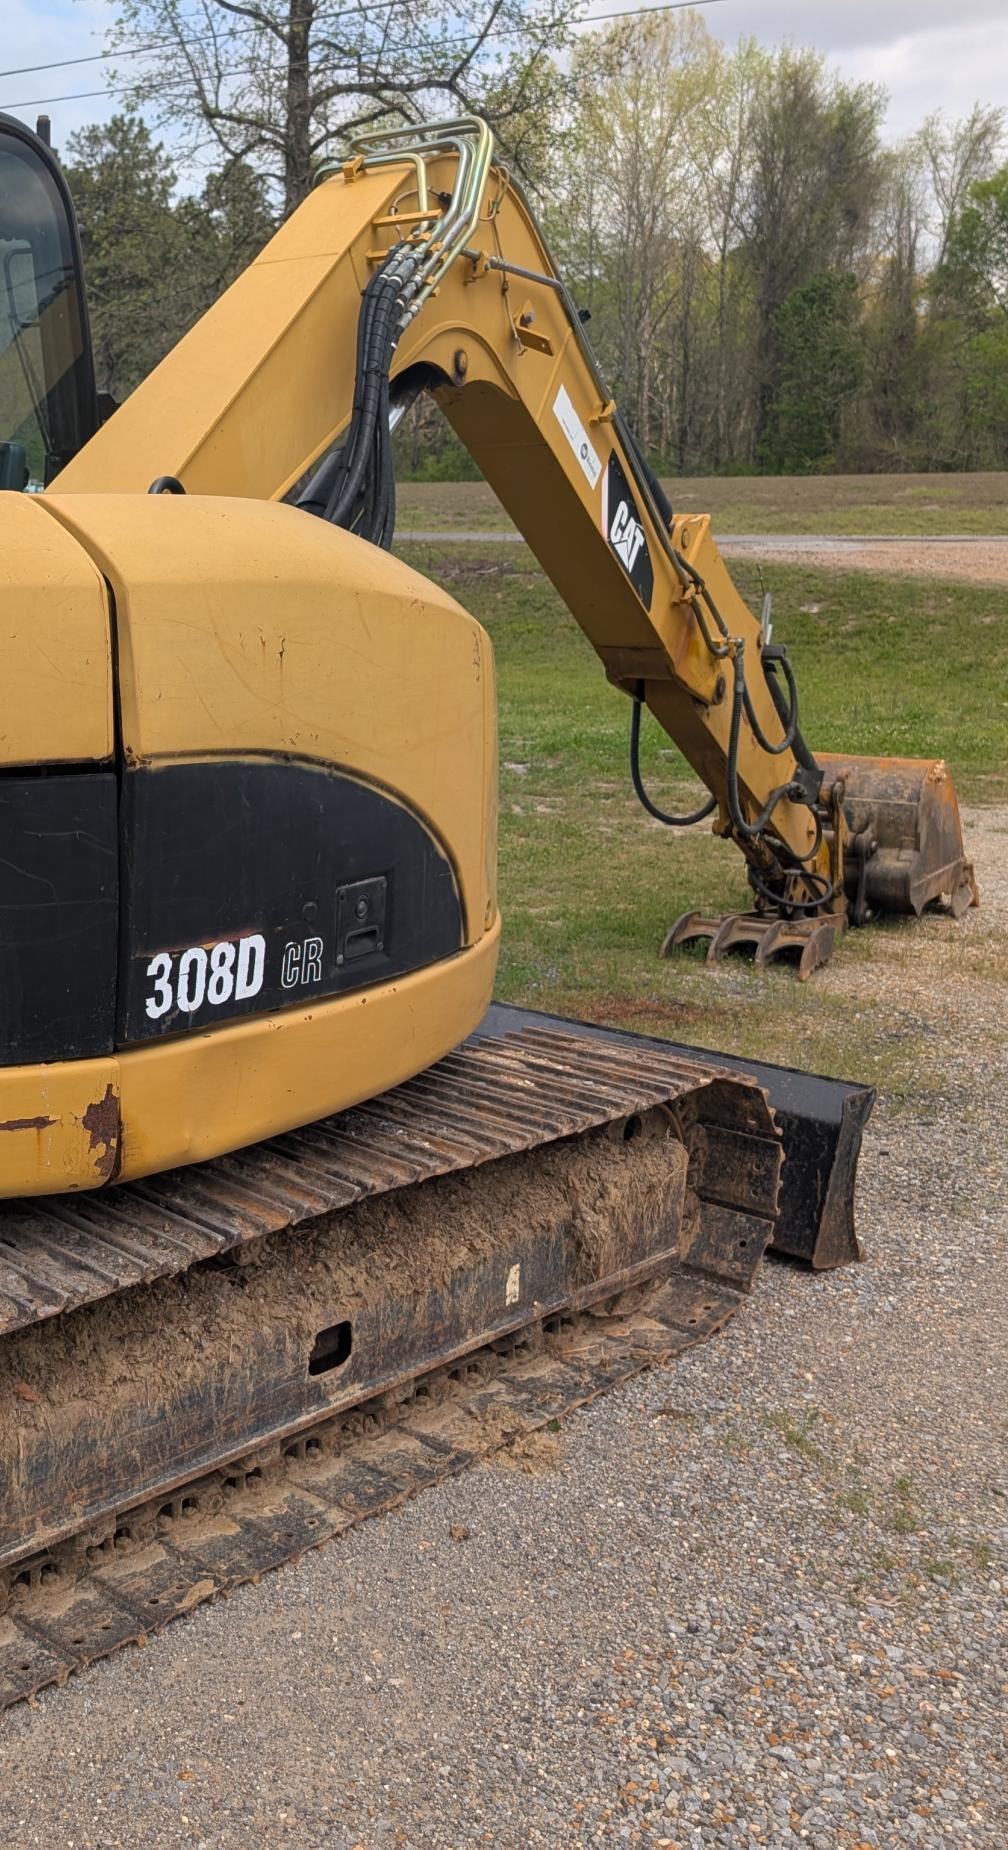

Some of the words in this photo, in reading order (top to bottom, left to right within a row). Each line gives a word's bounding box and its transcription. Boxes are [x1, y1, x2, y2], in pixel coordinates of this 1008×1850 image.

[610, 500, 645, 573] CAT
[145, 934, 266, 1019] 308D
[280, 937, 324, 988] CR
